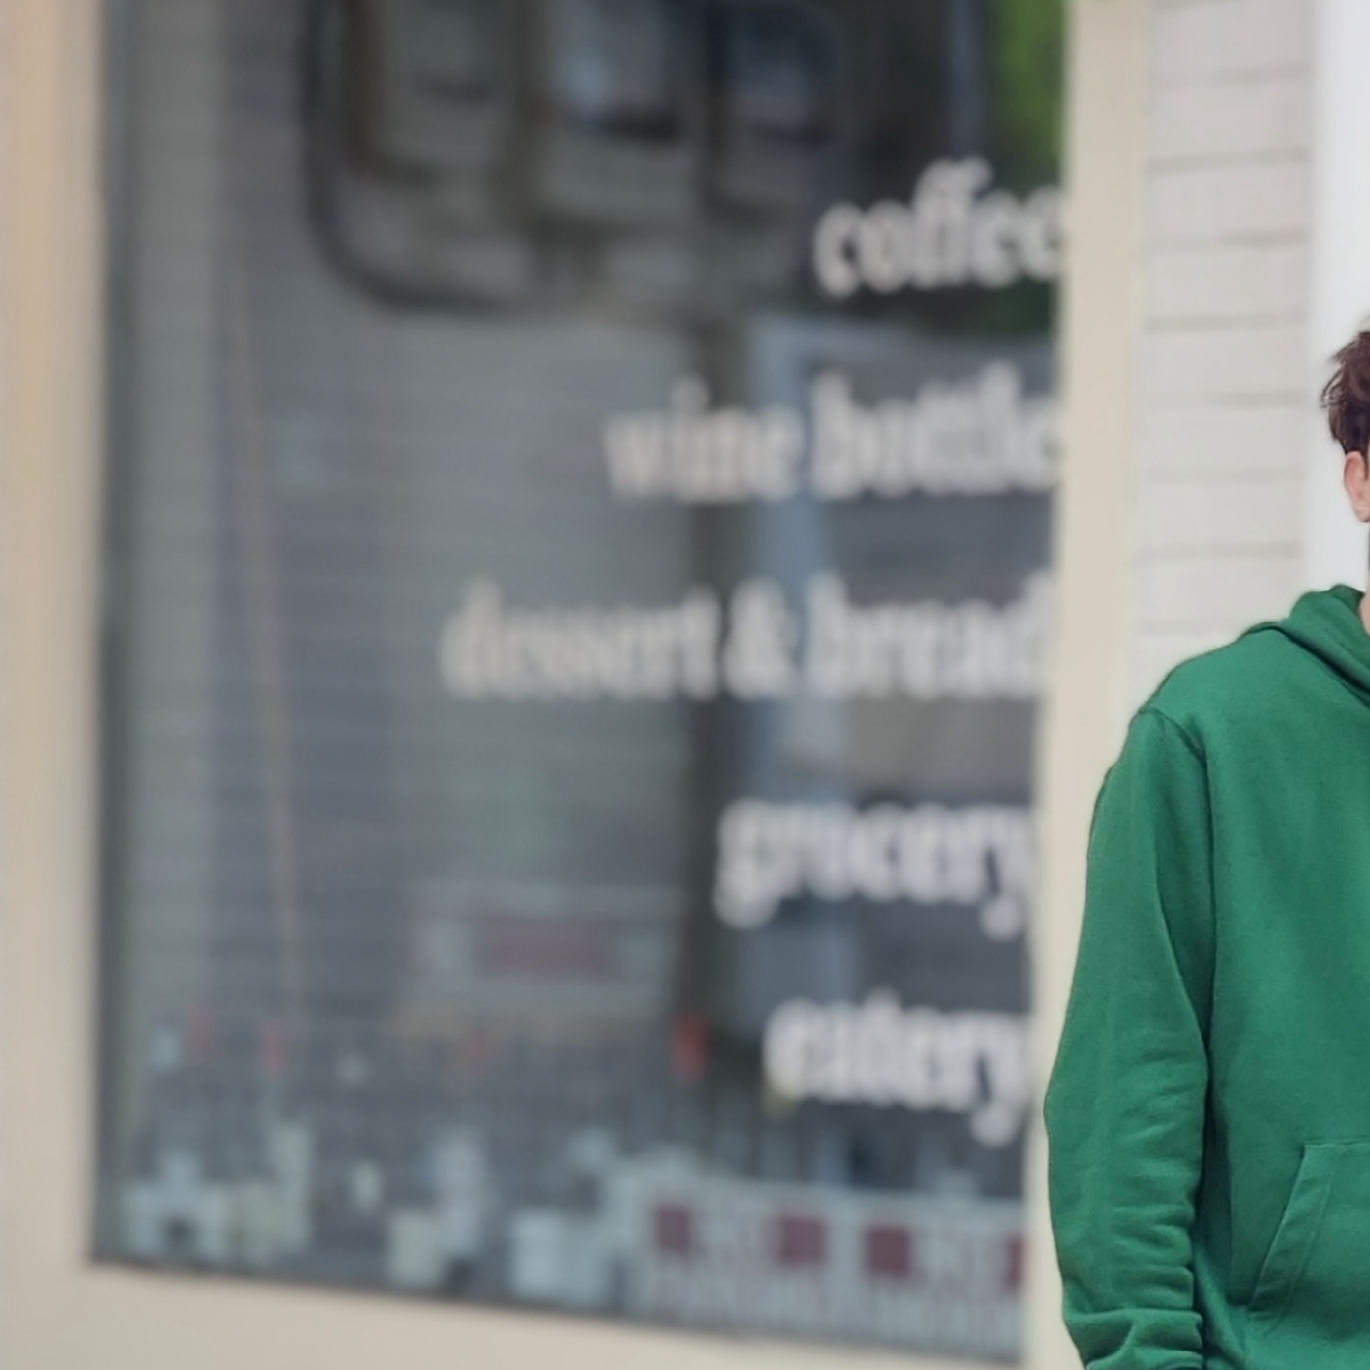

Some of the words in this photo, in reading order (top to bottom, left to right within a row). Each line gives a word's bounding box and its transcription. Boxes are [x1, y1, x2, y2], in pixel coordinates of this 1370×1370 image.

[813, 158, 1064, 292] coffee
[605, 378, 803, 500] wine
[810, 362, 1060, 497] bottle
[440, 578, 722, 698] dessert
[724, 580, 800, 700] &
[716, 798, 1032, 940] grocery
[763, 990, 1027, 1146] eatery
